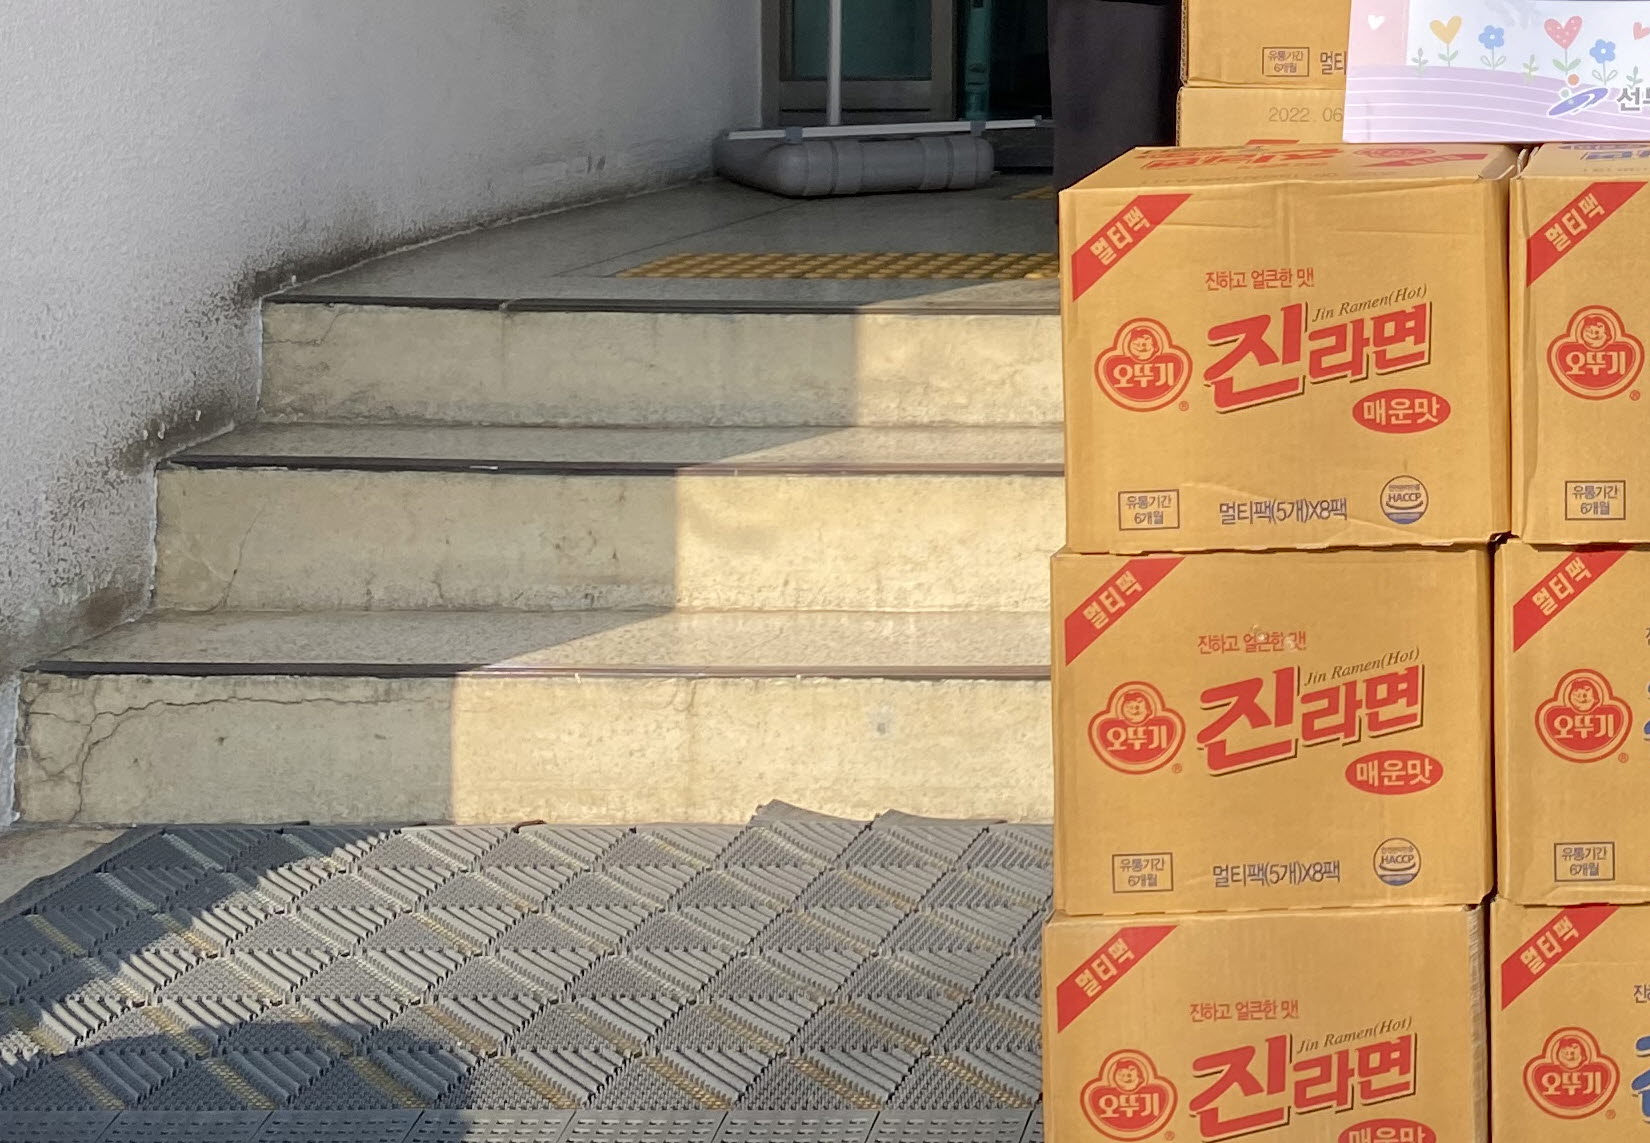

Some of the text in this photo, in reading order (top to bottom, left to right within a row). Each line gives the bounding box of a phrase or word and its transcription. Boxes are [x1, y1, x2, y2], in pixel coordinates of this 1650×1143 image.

[1090, 206, 1151, 266] 멀티팩
[1544, 193, 1605, 252] 멀티팩
[1205, 271, 1247, 290] 진하고
[1251, 270, 1293, 288] 얼큰한
[1312, 306, 1334, 323] Jin
[1203, 301, 1431, 413] 진라면
[1565, 351, 1626, 376] 오뚜기
[1113, 364, 1174, 388] 오뚜기
[1363, 396, 1441, 426] 매운맛
[1126, 494, 1172, 510] 유통기간
[1572, 484, 1619, 500] 유통기간
[1082, 570, 1143, 630] 멀티팩
[1532, 557, 1592, 616] 멀티팩
[1304, 670, 1326, 687] Jin
[1196, 664, 1424, 777] 진라면
[1553, 714, 1615, 740] 오뚜기
[1106, 723, 1168, 752] 오뚜기
[1355, 758, 1433, 787] 매운맛
[1520, 916, 1579, 975] 멀티팩
[1075, 937, 1135, 998] 멀티팩
[1189, 1032, 1418, 1143] 진라면
[1541, 1070, 1602, 1097] 오뚜기
[1098, 1092, 1161, 1119] 오뚜기
